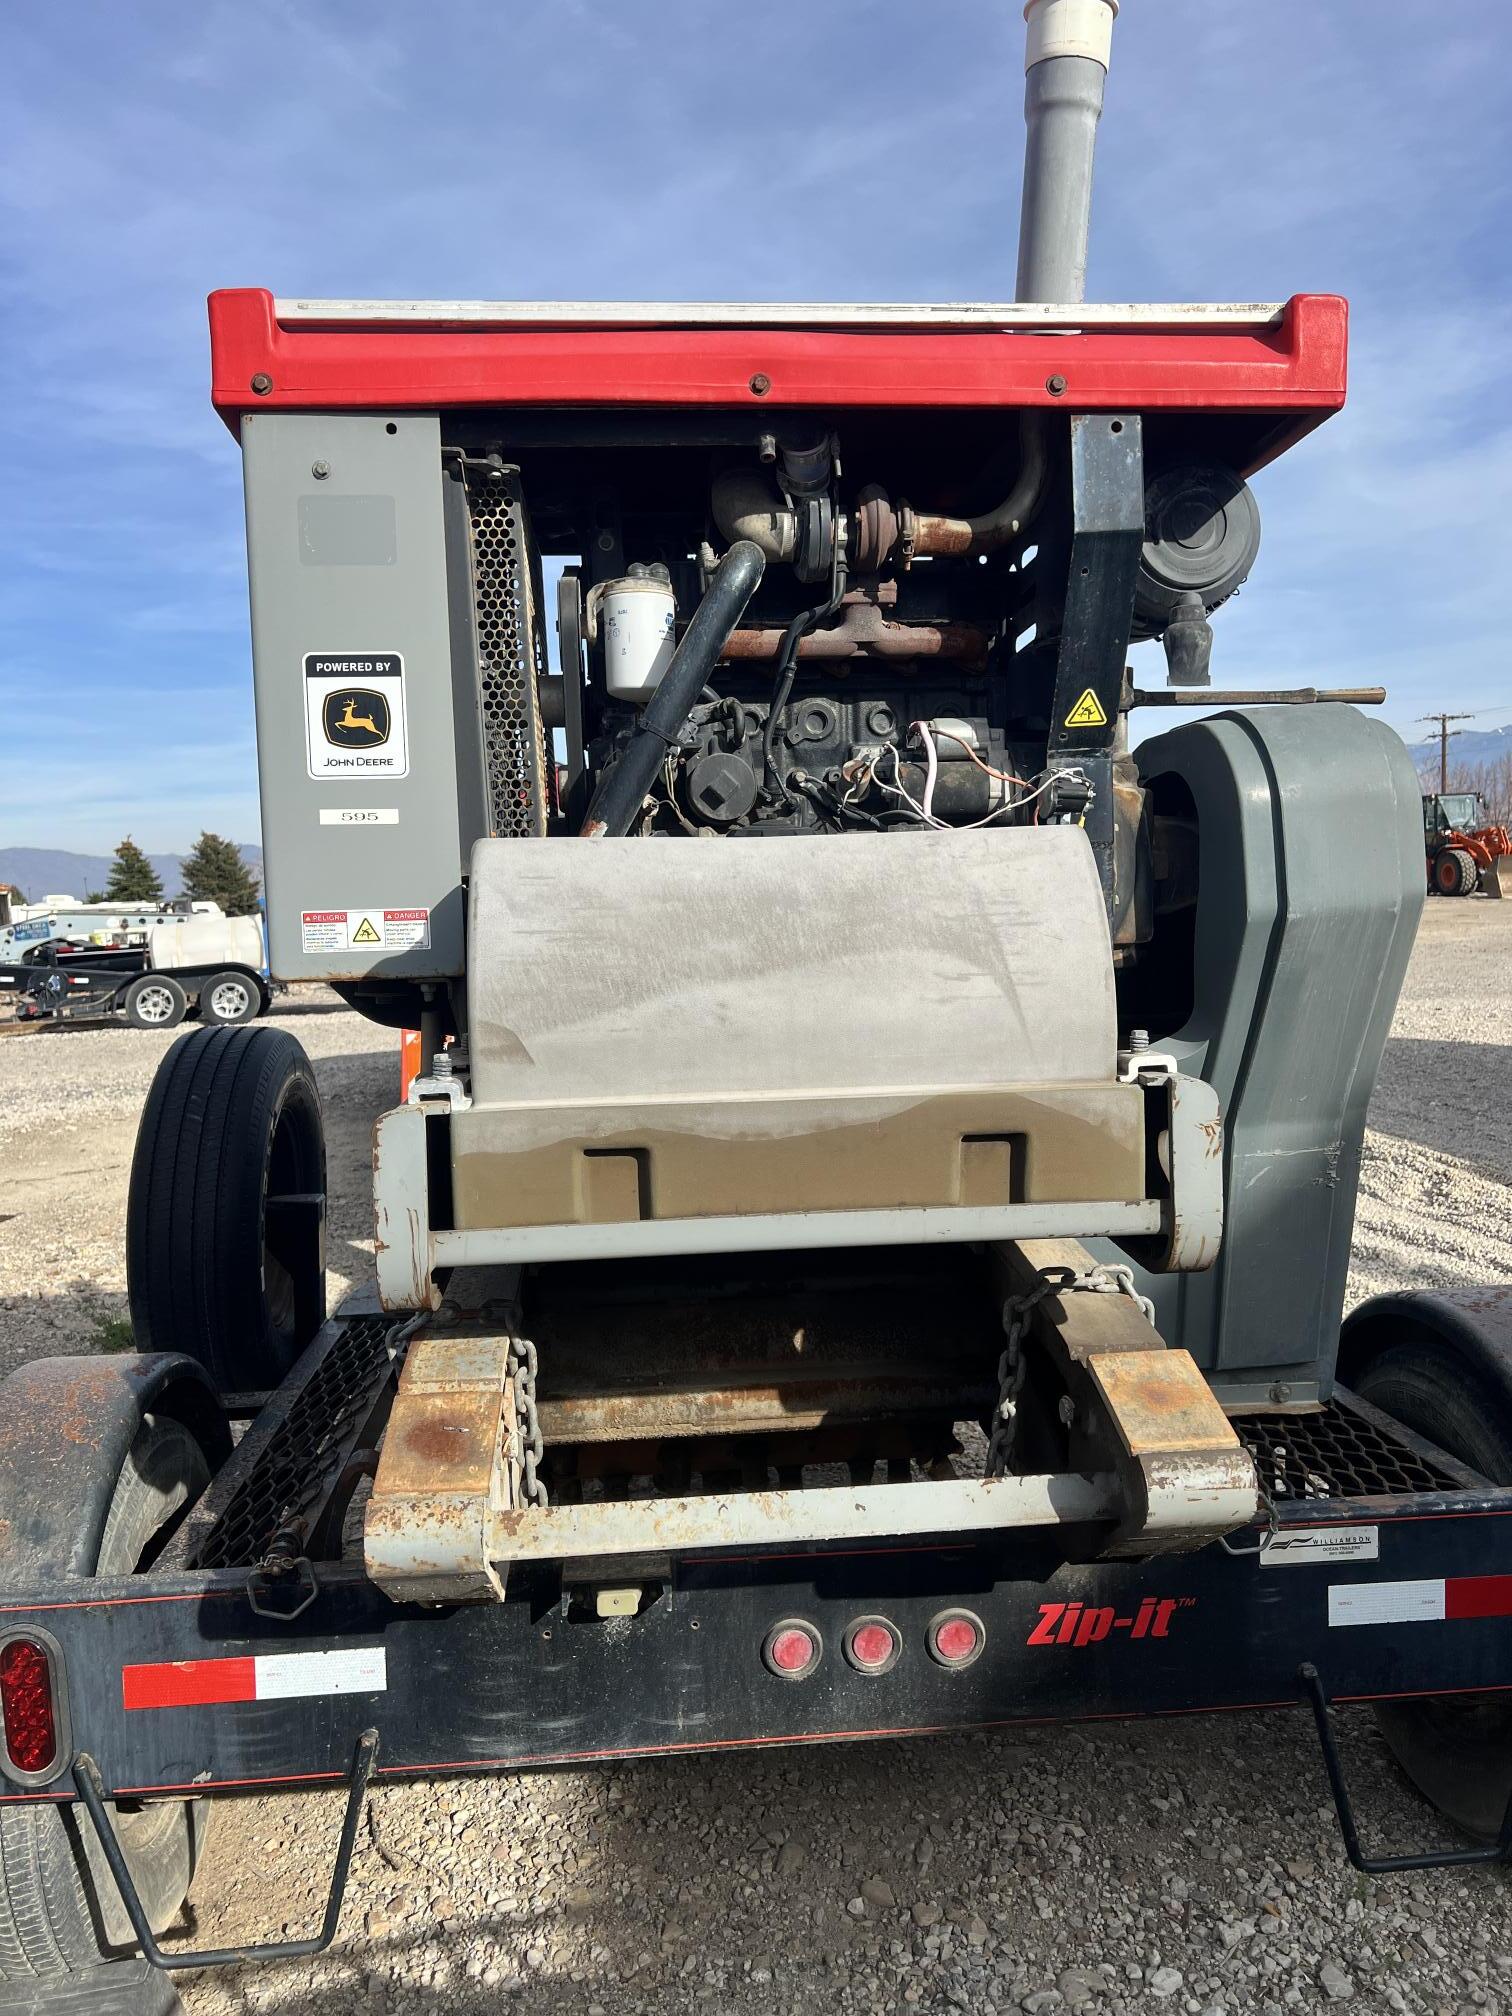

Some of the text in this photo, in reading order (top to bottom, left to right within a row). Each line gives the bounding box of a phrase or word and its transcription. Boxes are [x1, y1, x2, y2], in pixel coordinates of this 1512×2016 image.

[316, 662, 391, 672] POWERED BY
[323, 757, 394, 767] JOHN DEERE
[341, 812, 379, 821] 595
[1312, 1536, 1371, 1545] WILLIAMSON
[1026, 1597, 1177, 1647] Zip-it
